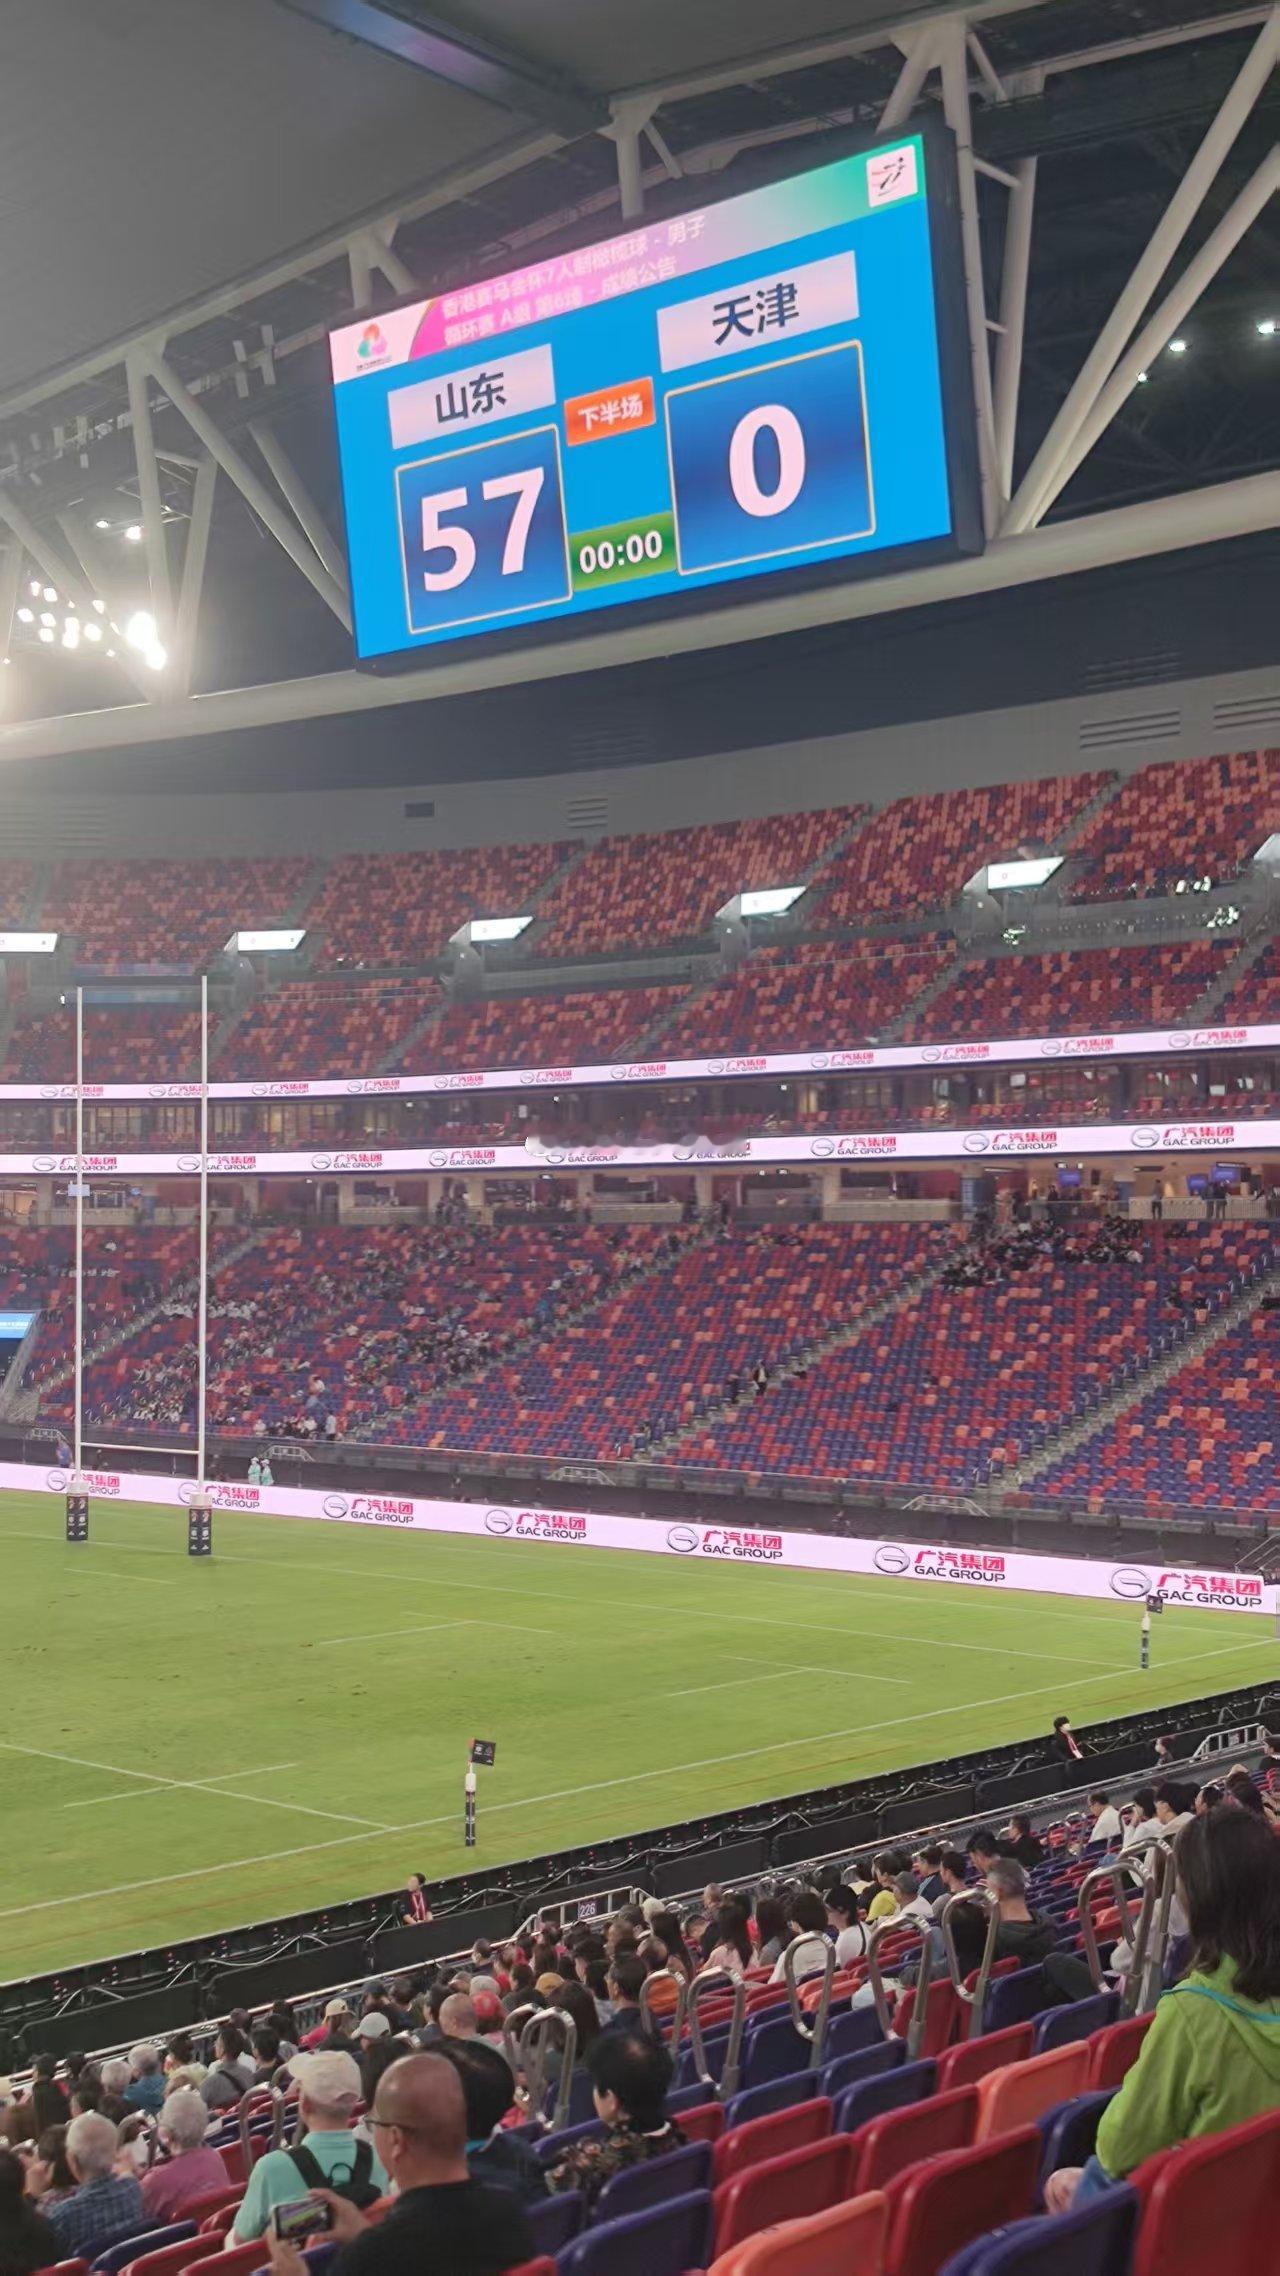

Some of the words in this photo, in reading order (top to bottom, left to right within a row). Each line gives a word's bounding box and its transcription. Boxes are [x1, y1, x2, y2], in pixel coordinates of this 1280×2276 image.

[713, 282, 800, 346] 天津
[434, 371, 507, 424] 山东
[577, 394, 644, 432] 下半场
[728, 404, 806, 518] 0
[419, 466, 546, 592] 57
[579, 530, 663, 575] 00:00
[89, 1487, 120, 1495] GROUP
[205, 1485, 259, 1500] 广汽集团
[225, 1498, 260, 1509] GROUP
[351, 1498, 413, 1515] 广汽集团
[351, 1511, 373, 1519] GAC
[375, 1512, 414, 1523] GROUP
[516, 1512, 586, 1530] 广汽集团
[516, 1526, 540, 1536] GAC
[543, 1528, 587, 1540] GROUP
[703, 1530, 782, 1550] 广汽集团
[702, 1544, 731, 1555] GAC
[733, 1547, 783, 1560] GROUP
[914, 1550, 1005, 1572] 广汽集团
[914, 1565, 946, 1577] GAC
[950, 1569, 1005, 1582] GROUP
[1157, 1572, 1261, 1596] 广汽集团
[1157, 1589, 1193, 1601] GAC
[1197, 1593, 1262, 1607] GROUP
[580, 1902, 596, 1917] 226
